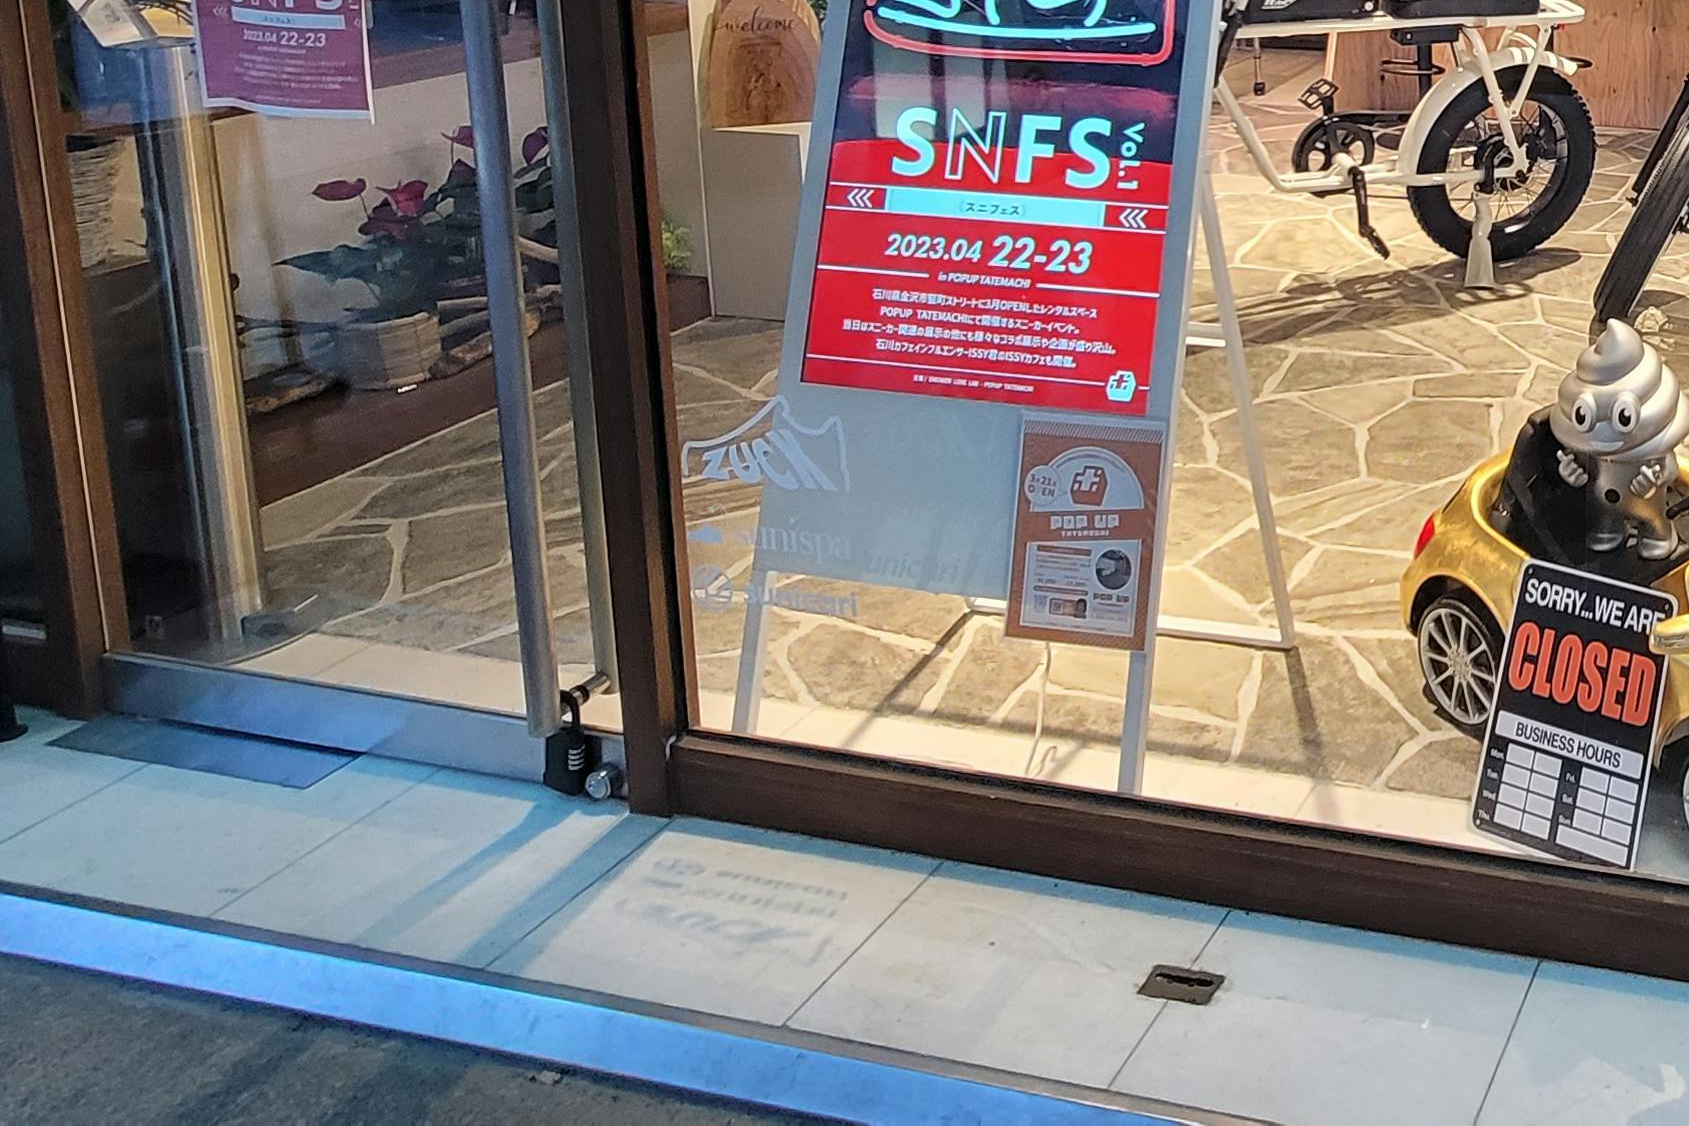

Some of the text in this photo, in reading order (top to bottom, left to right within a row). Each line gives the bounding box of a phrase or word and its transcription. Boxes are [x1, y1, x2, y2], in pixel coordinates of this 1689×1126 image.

[714, 6, 794, 34] welcome
[280, 31, 326, 47] 22-23
[892, 107, 1112, 189] SNFS
[884, 234, 1093, 274] 2023.04 22-23
[948, 272, 979, 285] POPUP
[980, 275, 1031, 288] TATEMACHI
[880, 306, 914, 319] POPUP
[1050, 514, 1119, 529] POP UP
[1508, 621, 1657, 727] CLOSED
[1515, 721, 1622, 768] BUSINESS HOURS
